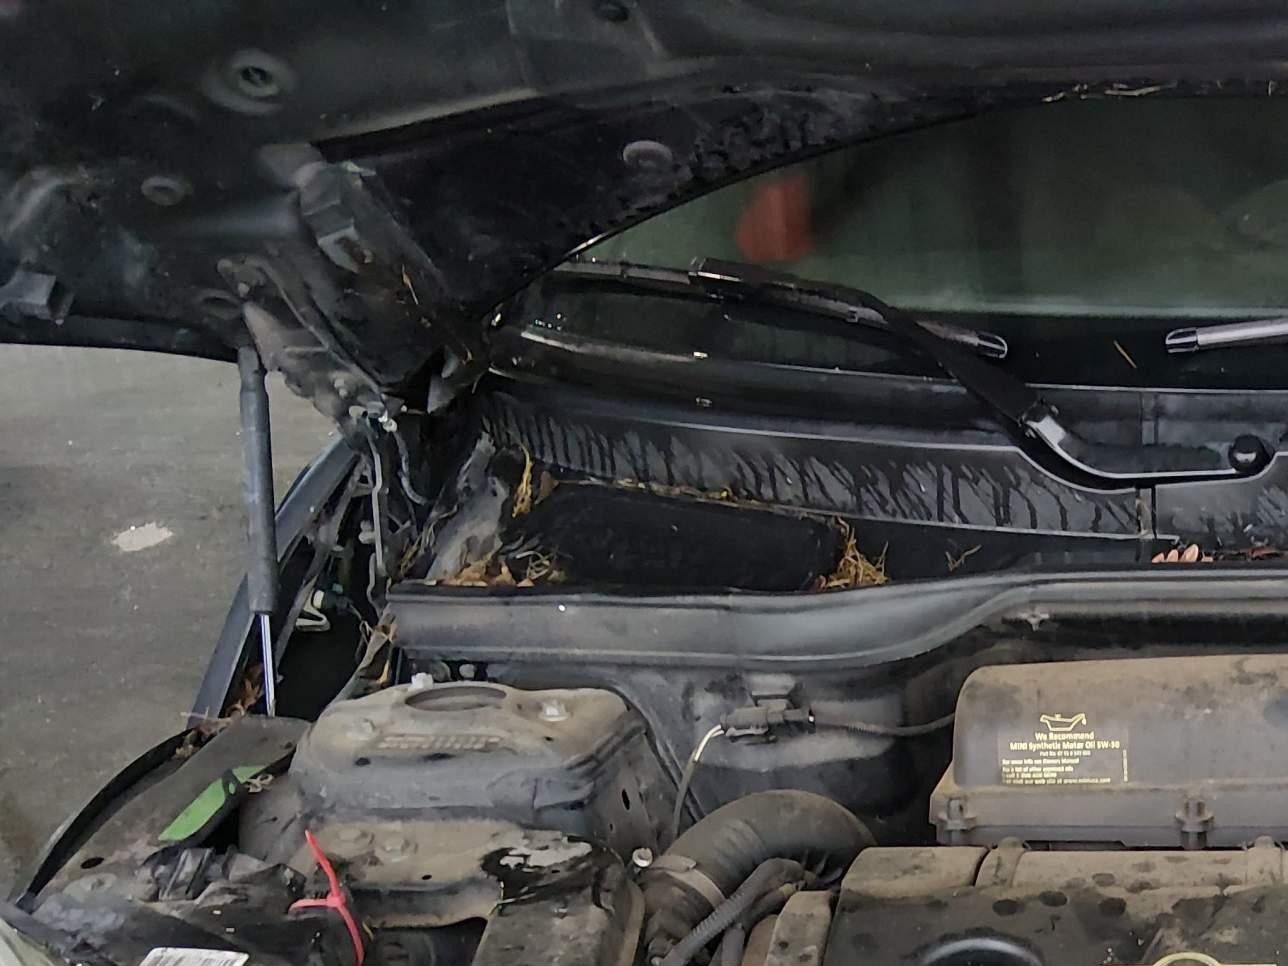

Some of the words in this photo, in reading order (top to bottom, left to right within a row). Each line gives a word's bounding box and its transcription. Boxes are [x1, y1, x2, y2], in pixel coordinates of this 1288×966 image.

[1034, 732, 1048, 741] We
[1049, 731, 1094, 740] Recommend
[1010, 742, 1028, 750] MINI
[1029, 741, 1061, 752] Synthetic
[1062, 741, 1084, 750] Motor
[1085, 740, 1096, 749] Oil
[1097, 740, 1120, 749] 5W-30
